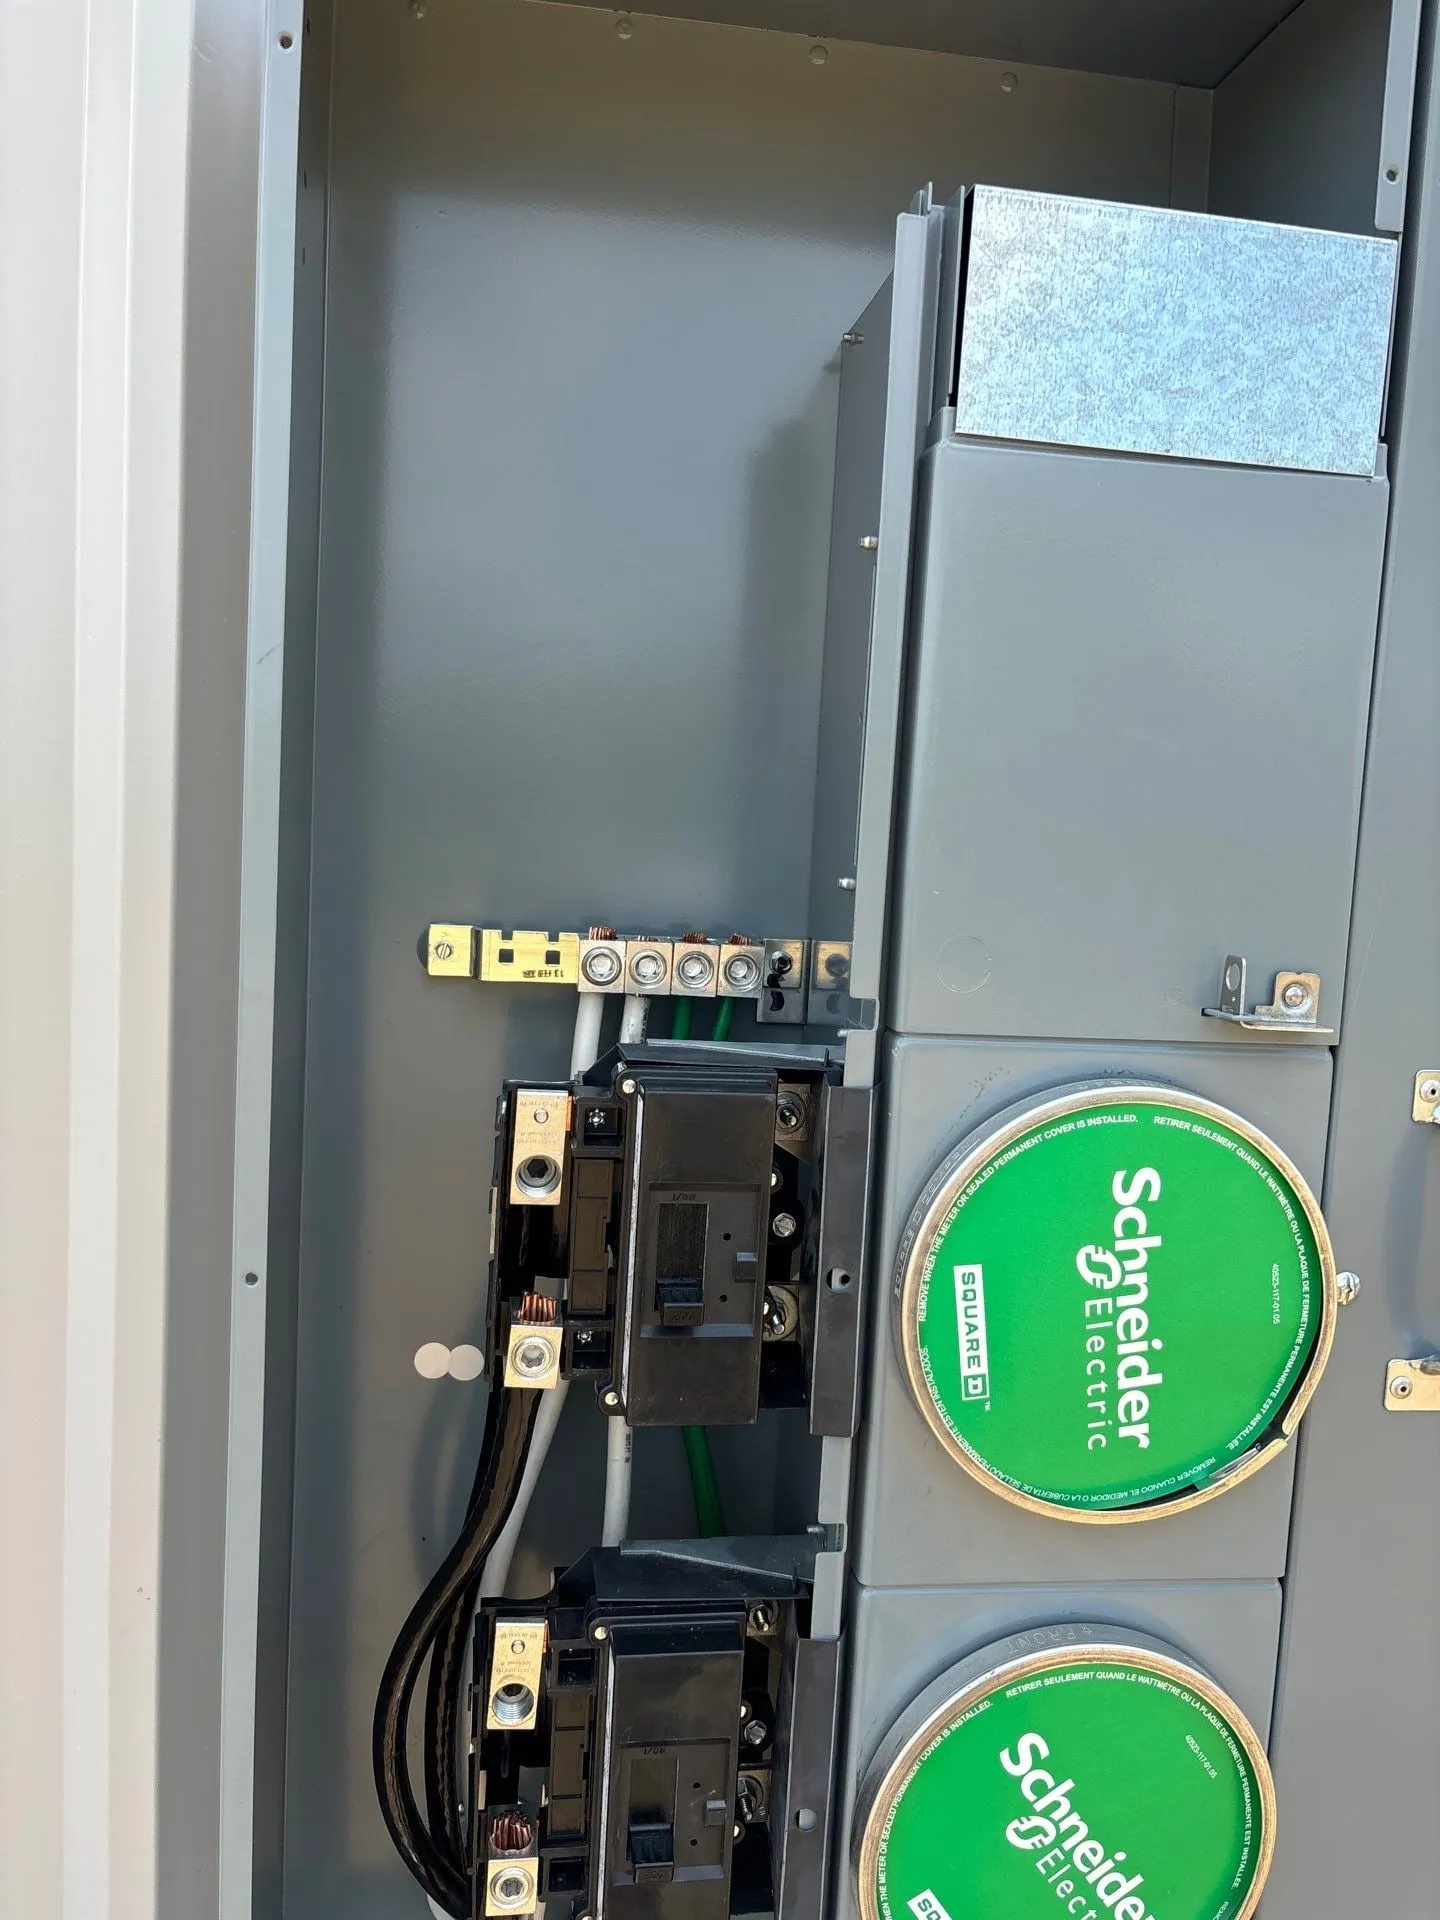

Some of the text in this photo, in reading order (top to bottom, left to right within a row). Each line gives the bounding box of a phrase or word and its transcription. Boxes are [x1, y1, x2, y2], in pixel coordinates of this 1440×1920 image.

[1154, 1116, 1192, 1130] RETIRER
[1191, 1124, 1238, 1151] SEULEMENT
[1236, 1148, 1260, 1170] QUAND
[1258, 1167, 1268, 1179] LE
[919, 1114, 1138, 1322] REMOVE WHEN THE METER OR SEALED PERMANENT COVER IS INSTALLED.
[1290, 1220, 1300, 1232] OU
[1294, 1233, 1302, 1245] LA
[1298, 1244, 1309, 1279] PLAQUE
[1302, 1280, 1310, 1292] DE
[1112, 1166, 1163, 1449] Schneider
[962, 1272, 980, 1368] SQUARE
[1295, 1294, 1310, 1345] FERMETURE
[919, 1345, 941, 1400] INSTALADOS.
[1084, 1298, 1113, 1450] Electric
[1270, 1345, 1300, 1398] PERMANENTE
[1260, 1398, 1273, 1414] EST
[950, 1426, 991, 1469] PERMANENTE
[989, 1467, 1022, 1488] SELLADO
[1177, 1456, 1216, 1481] REMOVER
[1021, 1484, 1034, 1493] DE
[1033, 1488, 1070, 1500] CUBIERTA
[1142, 1479, 1176, 1494] CUANDO
[1090, 1492, 1128, 1502] MEDIDOR
[1044, 1672, 1094, 1686] SEULEMENT
[1096, 1671, 1125, 1680] QUAND
[1126, 1673, 1137, 1682] LE
[1006, 1680, 1042, 1698] RETIRER
[1181, 1692, 1192, 1702] OU
[1191, 1699, 1200, 1709] LA
[1199, 1706, 1223, 1730] PLAQUE
[1220, 1727, 1229, 1739] DE
[1226, 1736, 1247, 1778] FERMETURE
[879, 1700, 993, 1920] HEN THE METER OR SEALED PERMANENT COVER IS INSTALLED.
[1242, 1777, 1252, 1829] PERMANENTE
[1000, 1732, 1156, 1920] Schneide
[1243, 1830, 1251, 1846] EST
